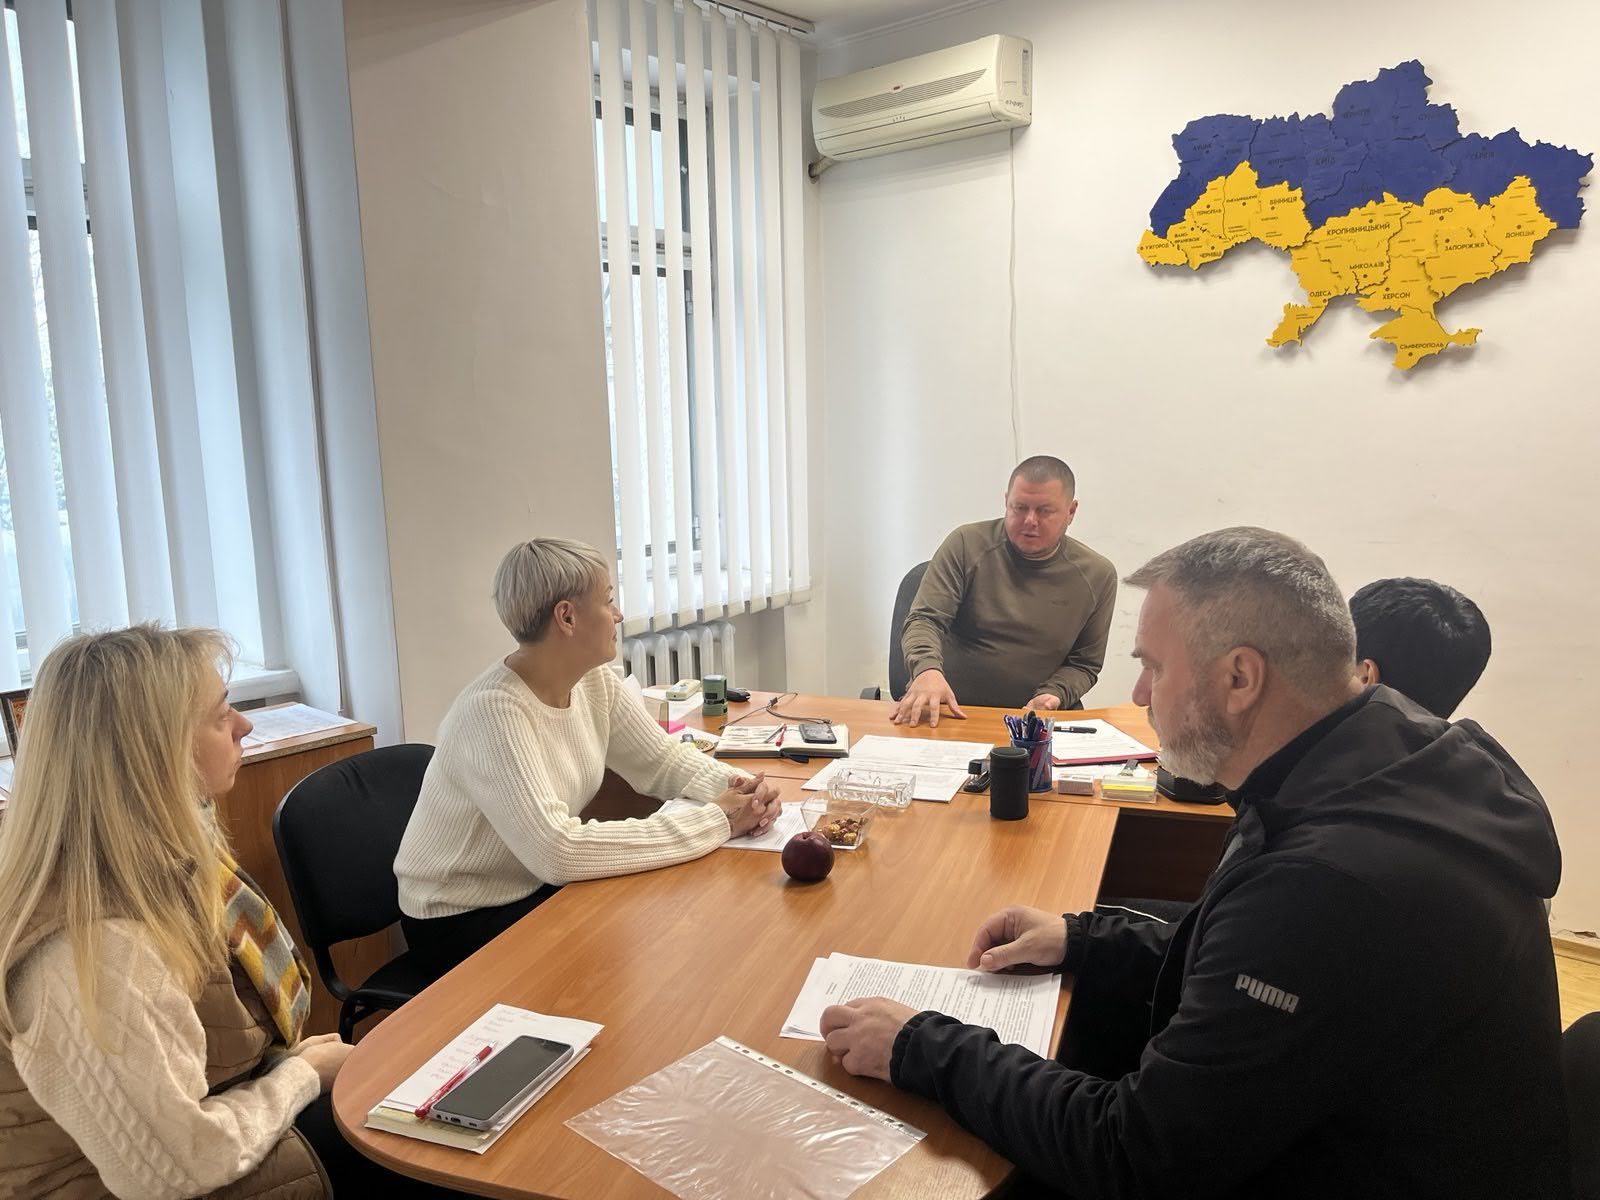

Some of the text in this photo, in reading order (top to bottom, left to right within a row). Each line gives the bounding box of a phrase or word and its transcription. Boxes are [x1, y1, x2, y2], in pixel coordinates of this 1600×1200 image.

[1429, 207, 1454, 215] ДНІПРО
[1326, 222, 1391, 236] КРОПИВНИЦЬКИЙ
[1505, 230, 1536, 239] ДОНЕЦЬК
[1145, 242, 1170, 250] УЖГОРОД
[1349, 261, 1385, 270] МИКОЛАЇВ
[1309, 290, 1332, 298] ОДЕСА
[1382, 291, 1411, 300] ХЕРСОН
[1235, 974, 1299, 1013] PUMA
